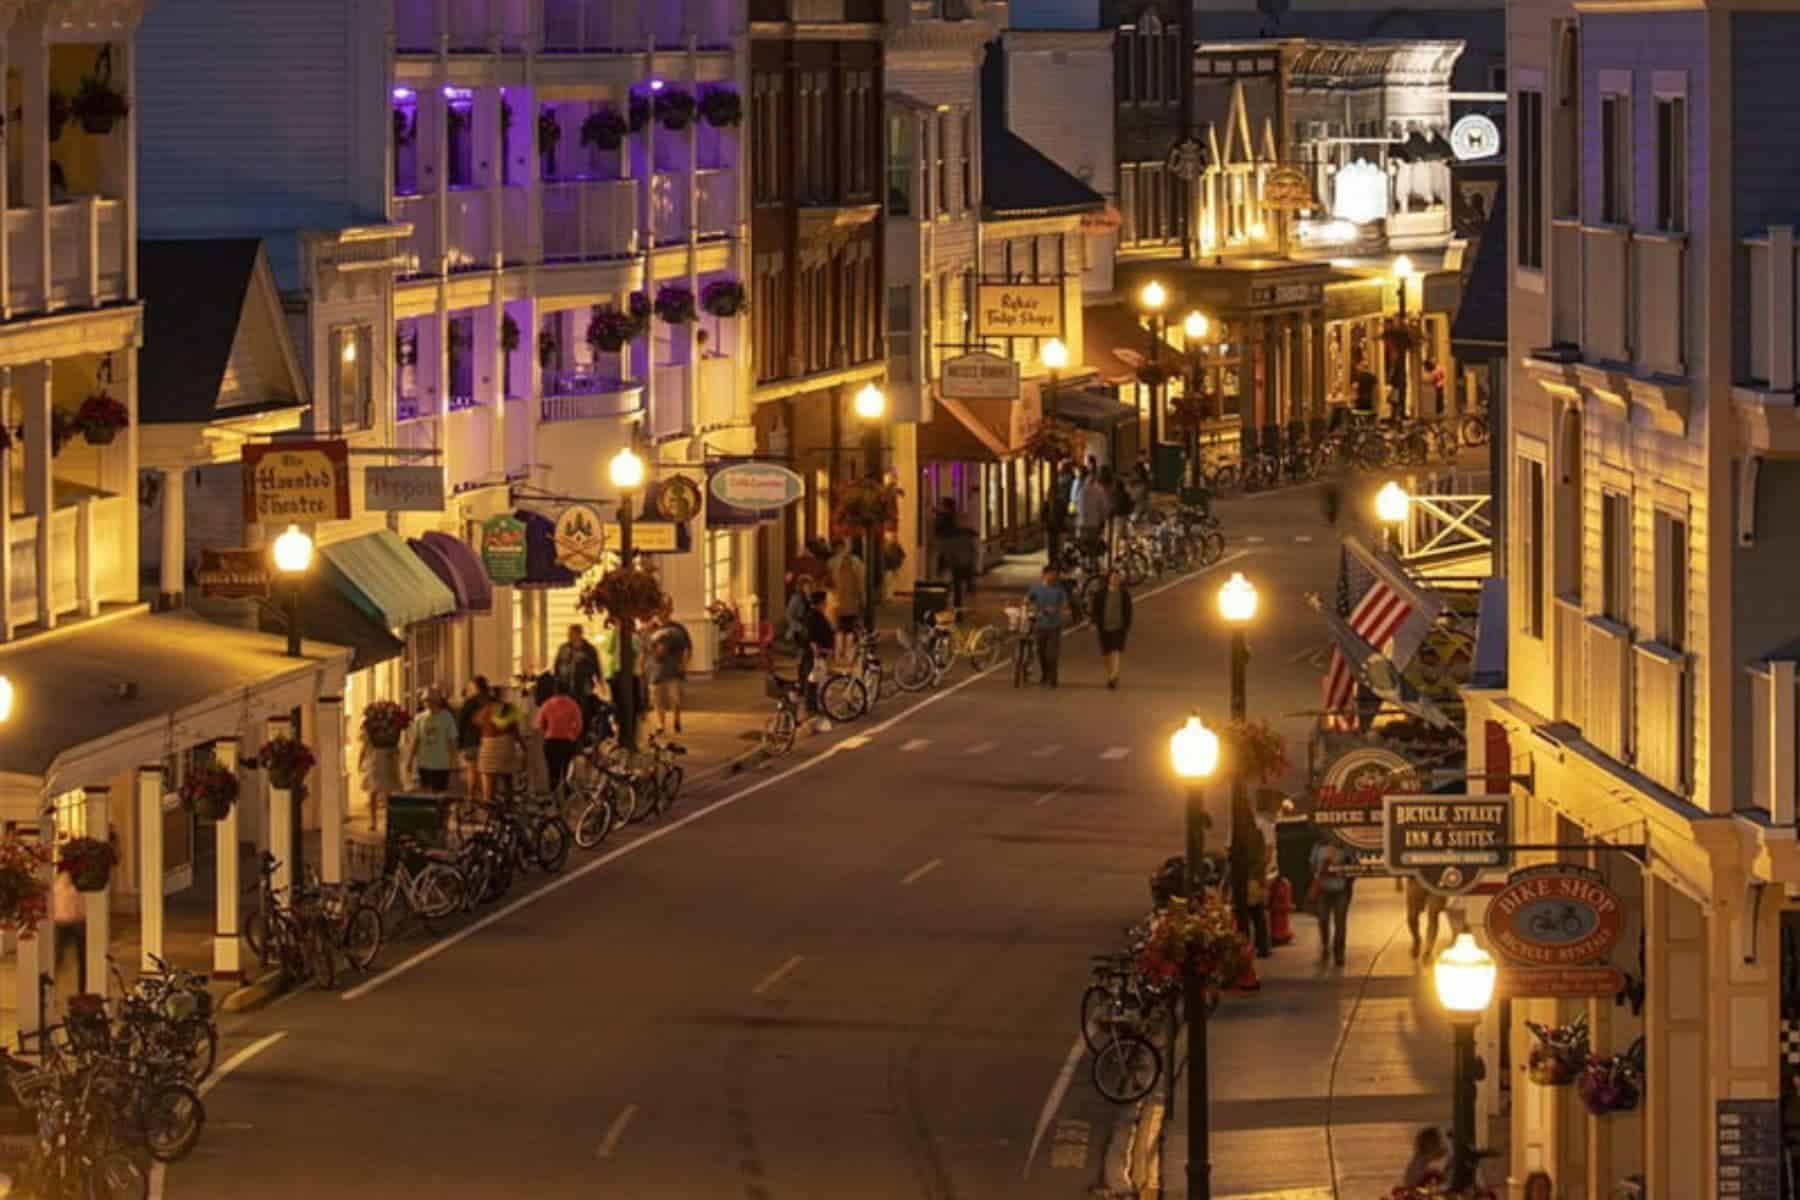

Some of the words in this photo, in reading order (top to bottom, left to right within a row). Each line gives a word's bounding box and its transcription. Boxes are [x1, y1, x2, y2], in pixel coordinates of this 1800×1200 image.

[256, 467, 329, 490] Haunted
[257, 494, 326, 515] Theatre
[1396, 805, 1447, 824] BICYCLE
[1453, 805, 1503, 824] STREET
[1405, 830, 1428, 847] INN
[1432, 831, 1443, 847] &
[1448, 829, 1495, 847] SUITES
[1499, 880, 1549, 915] BIKE
[1560, 879, 1616, 913] SHOP
